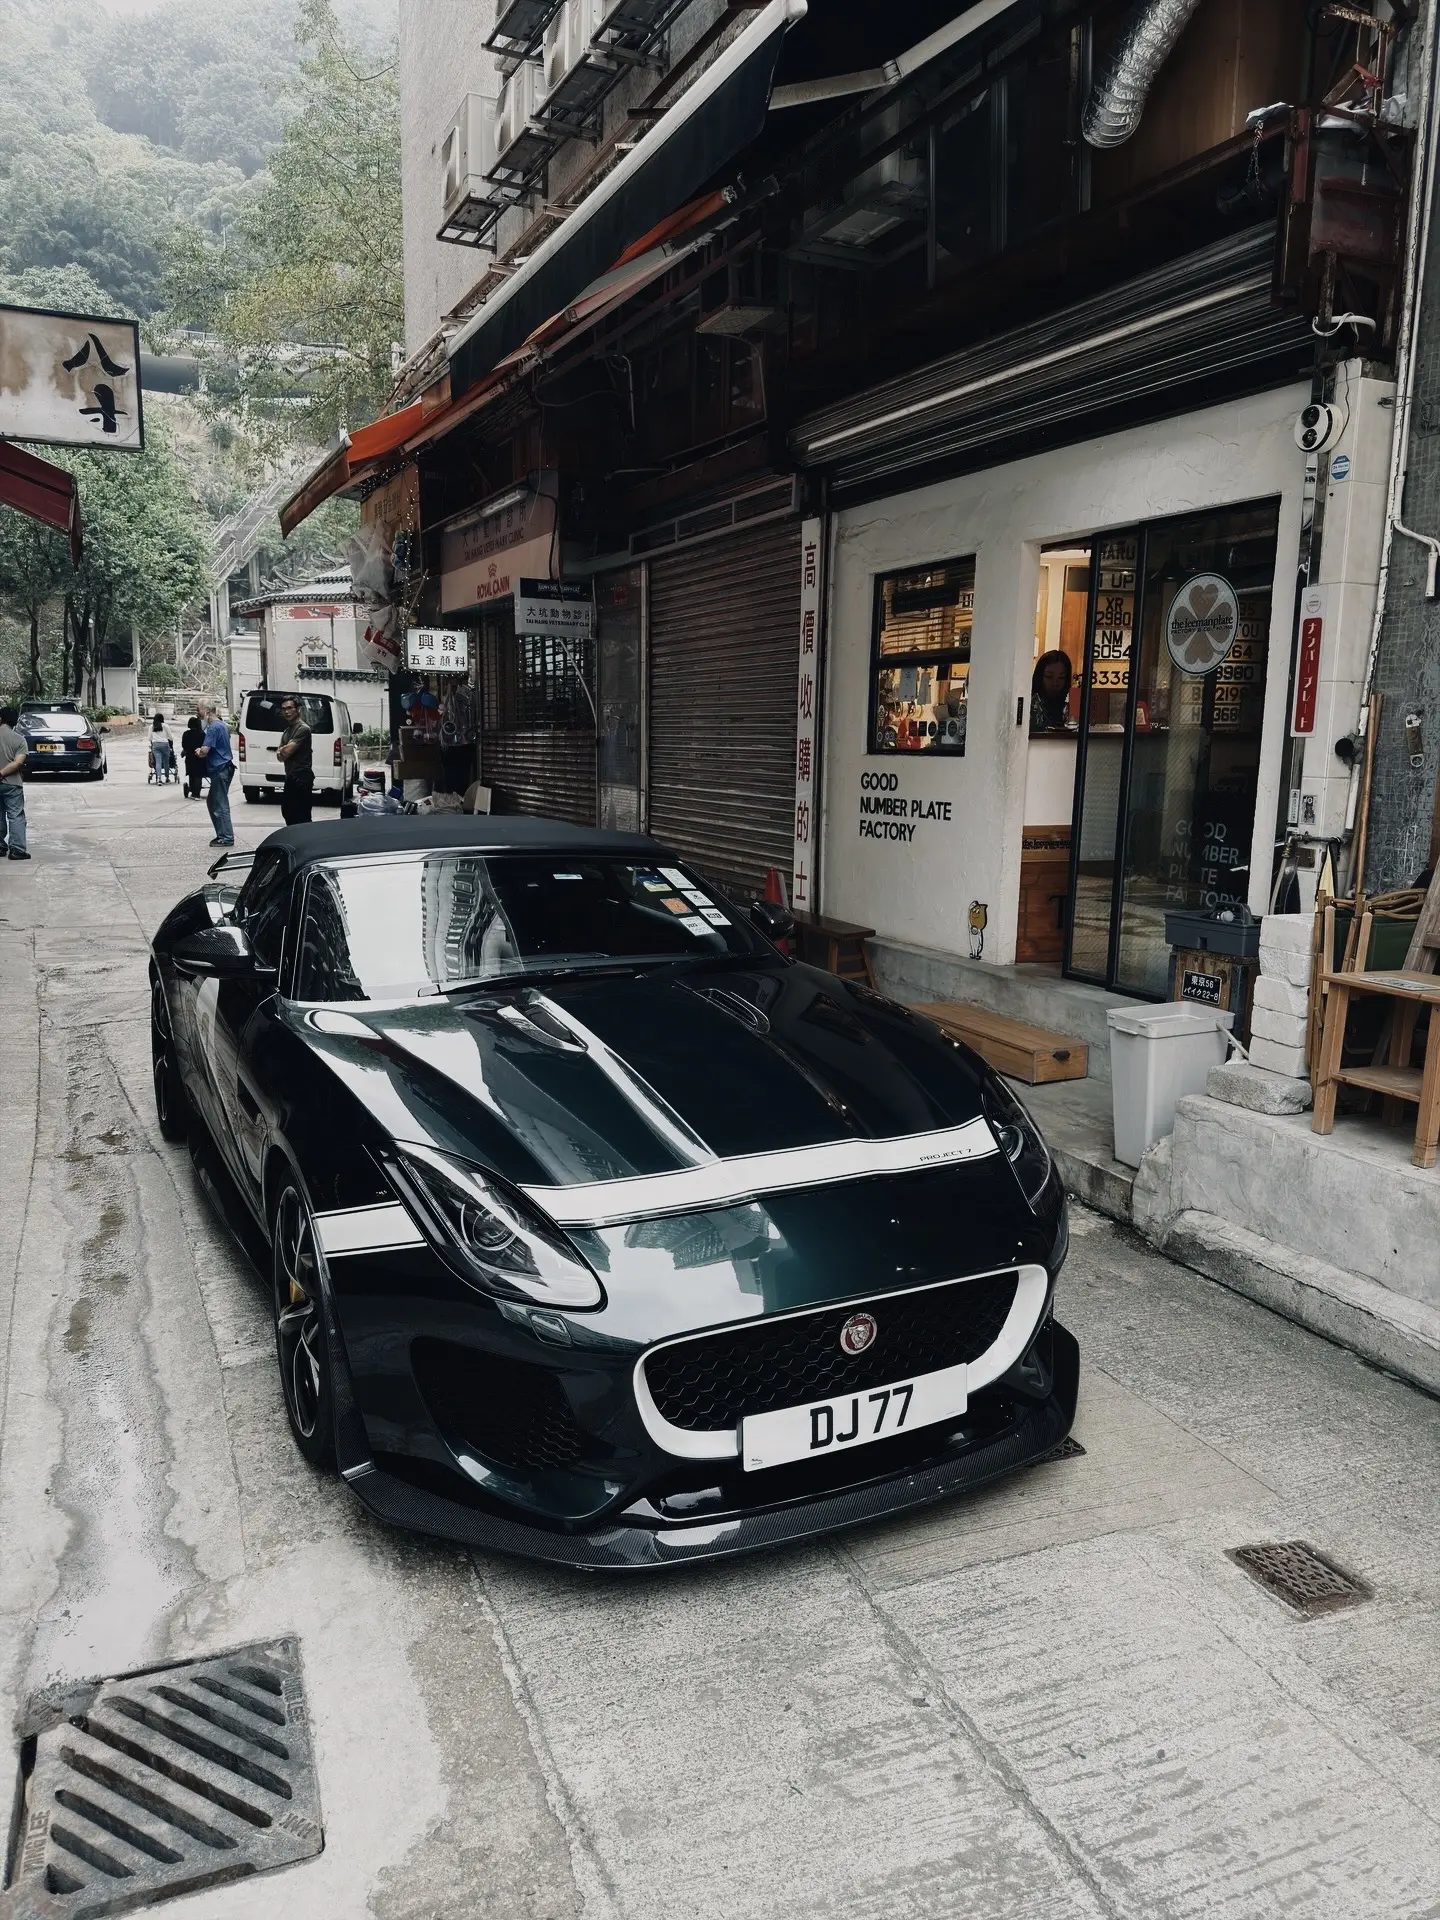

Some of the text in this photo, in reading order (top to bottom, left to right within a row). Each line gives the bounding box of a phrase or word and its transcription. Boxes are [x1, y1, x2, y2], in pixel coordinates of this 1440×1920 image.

[1106, 597, 1124, 612] XR
[1096, 612, 1131, 626] 2980
[418, 634, 457, 651] 興發
[1102, 630, 1123, 645] NM
[795, 541, 817, 902] 高價收購的士
[860, 772, 898, 791] GOOD
[860, 796, 952, 821] NUMBER PLATE
[859, 819, 916, 842] FACTORY
[1169, 863, 1218, 885] PLTE
[919, 1149, 963, 1162] PROJECT
[809, 1383, 914, 1450] DJ 77
[27, 1809, 51, 1841] LEE
